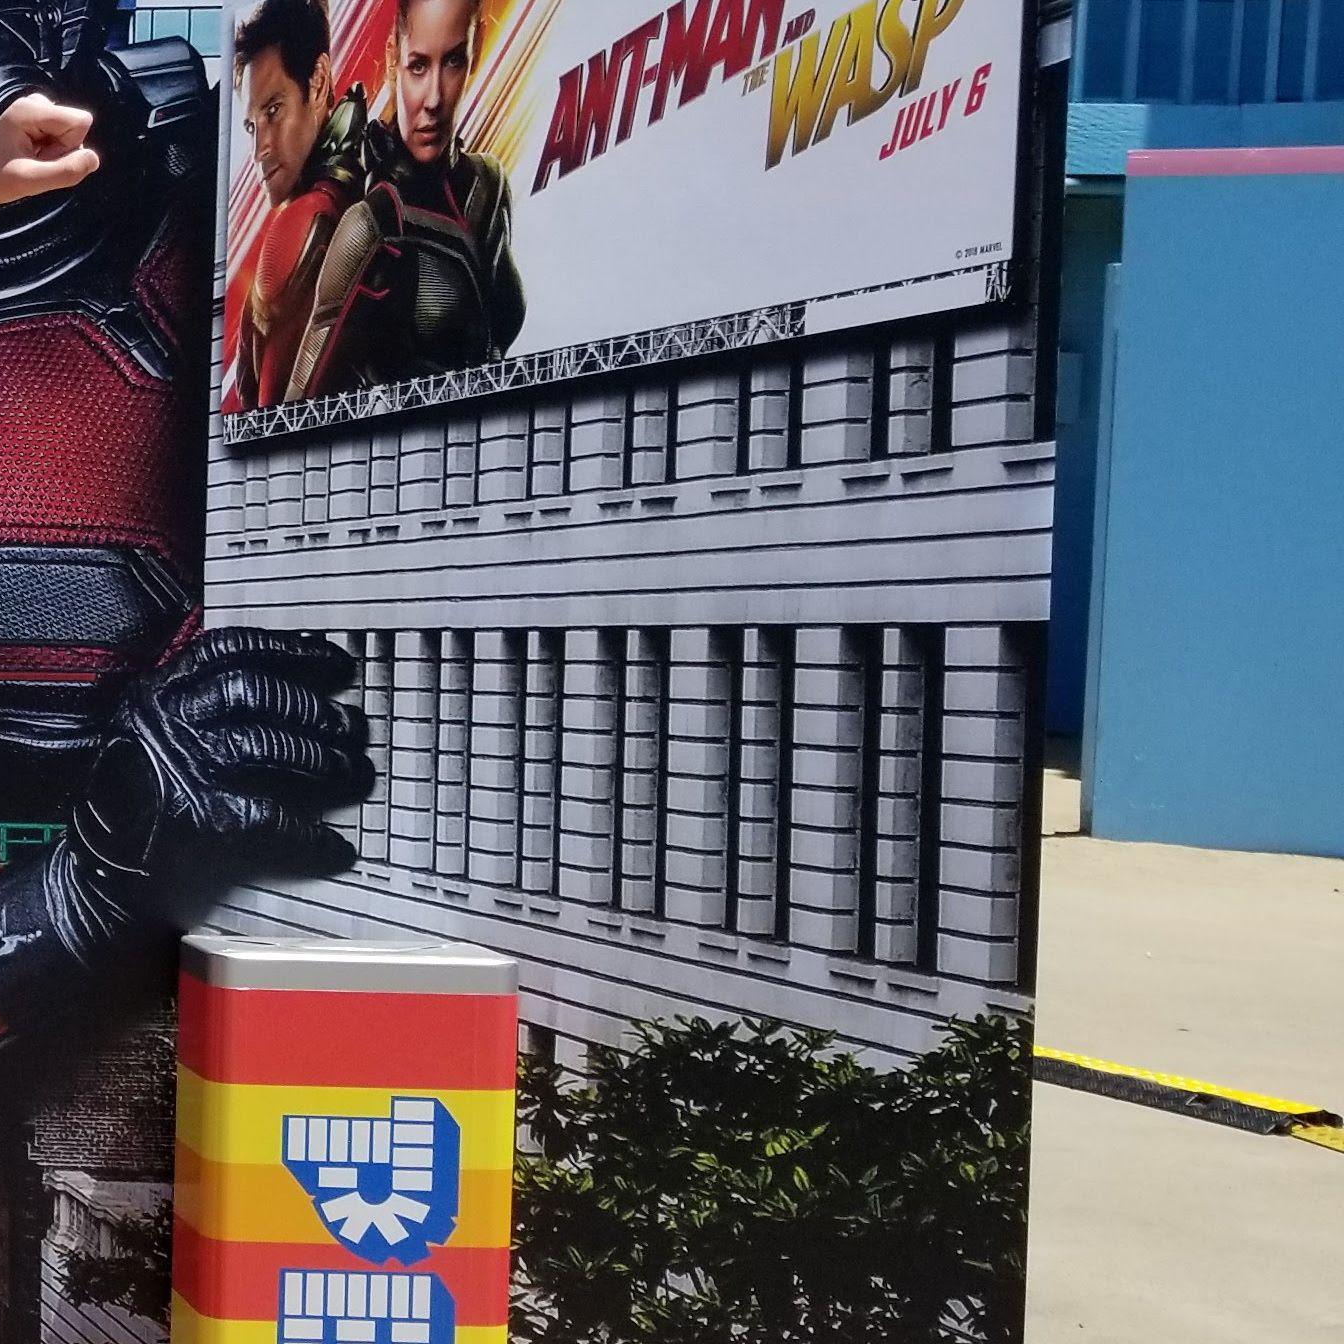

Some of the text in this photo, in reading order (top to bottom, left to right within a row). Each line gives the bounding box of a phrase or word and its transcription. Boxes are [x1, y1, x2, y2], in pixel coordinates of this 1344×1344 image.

[782, 8, 815, 47] AND
[742, 60, 770, 96] THE
[879, 62, 992, 160] JULY 6
[979, 242, 1002, 253] MARVEL
